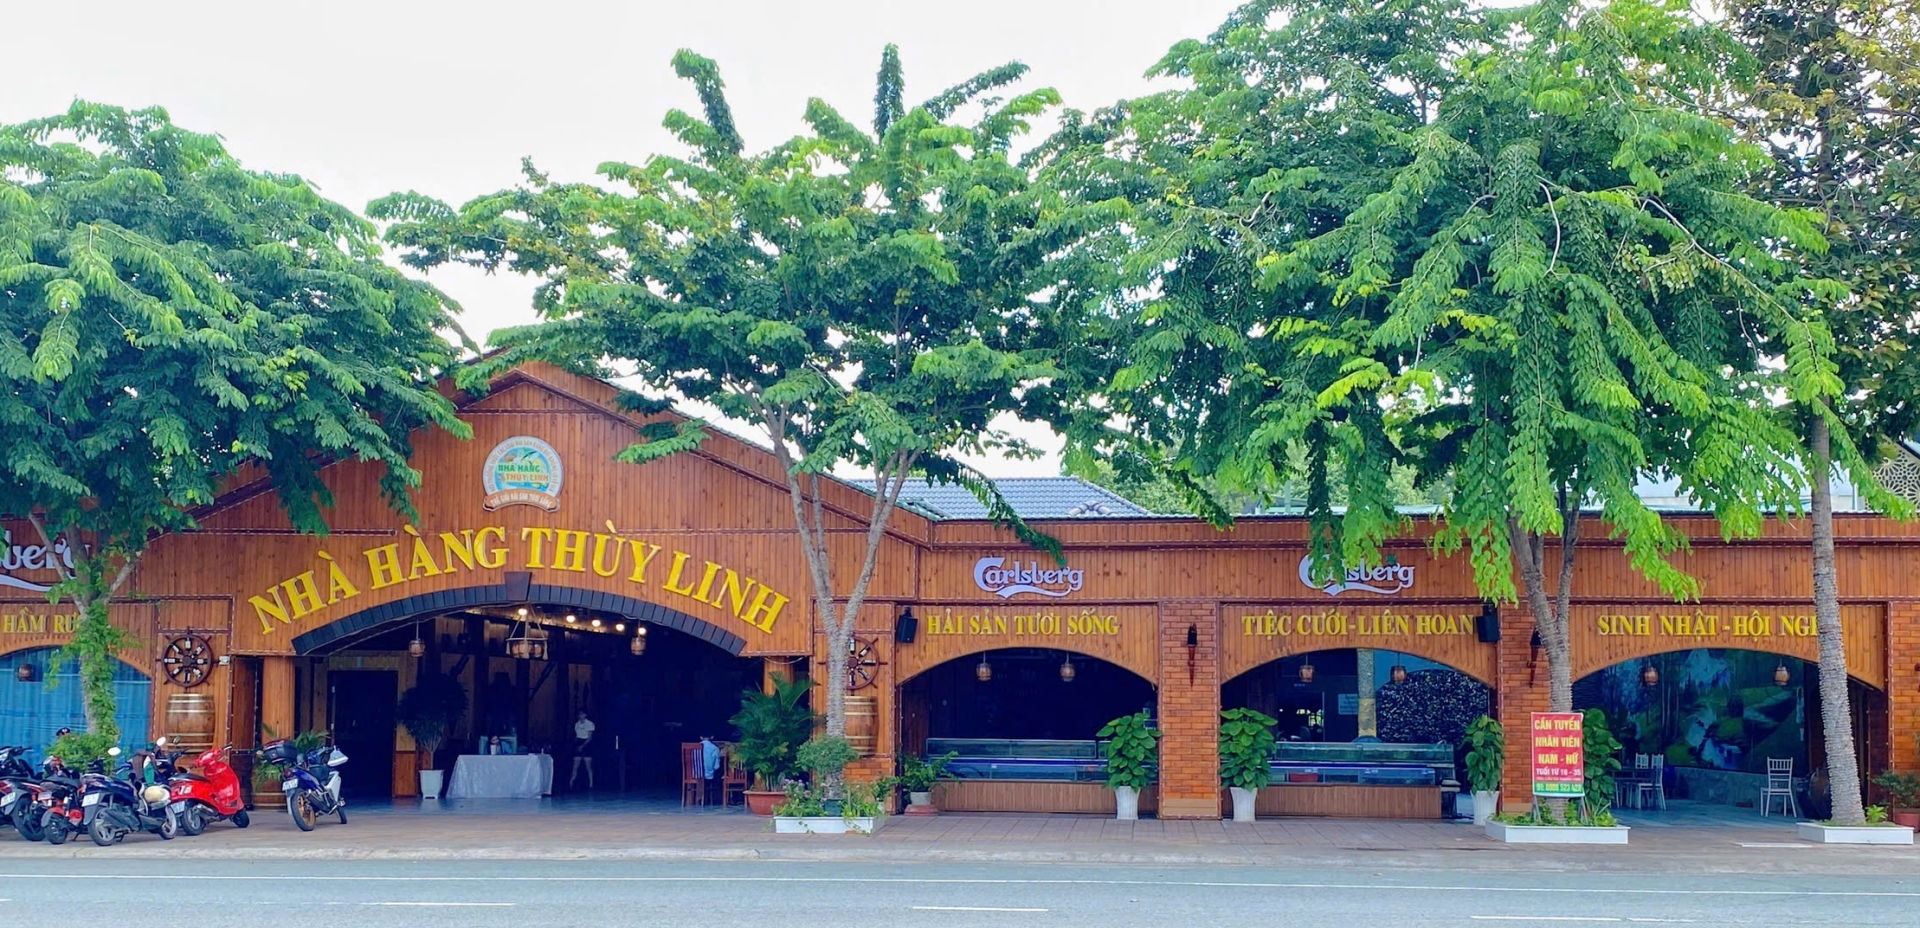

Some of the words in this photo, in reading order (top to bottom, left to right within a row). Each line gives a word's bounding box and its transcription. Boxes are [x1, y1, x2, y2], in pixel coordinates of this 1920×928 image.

[248, 550, 361, 635] NHÀ
[363, 524, 510, 590] HÀNG
[521, 519, 662, 584] THÙY
[662, 551, 790, 635] LINH
[974, 556, 1084, 598] Carlsberg
[3, 606, 46, 633] HẦM
[53, 611, 81, 633] RƯ
[926, 608, 963, 635] HẢI
[969, 608, 1007, 635] SẢN
[1014, 613, 1062, 635] TƯƠI
[1067, 608, 1120, 635] SỐNG
[1241, 609, 1291, 640] TIỆC
[1415, 614, 1474, 636] HOAN
[1597, 614, 1650, 636] SINH
[1660, 609, 1719, 640] NHẬT
[1535, 734, 1559, 748] NHÂN
[1561, 735, 1580, 748] VIÊN
[1538, 753, 1558, 765] NAM
[1565, 752, 1579, 765] NỮ
